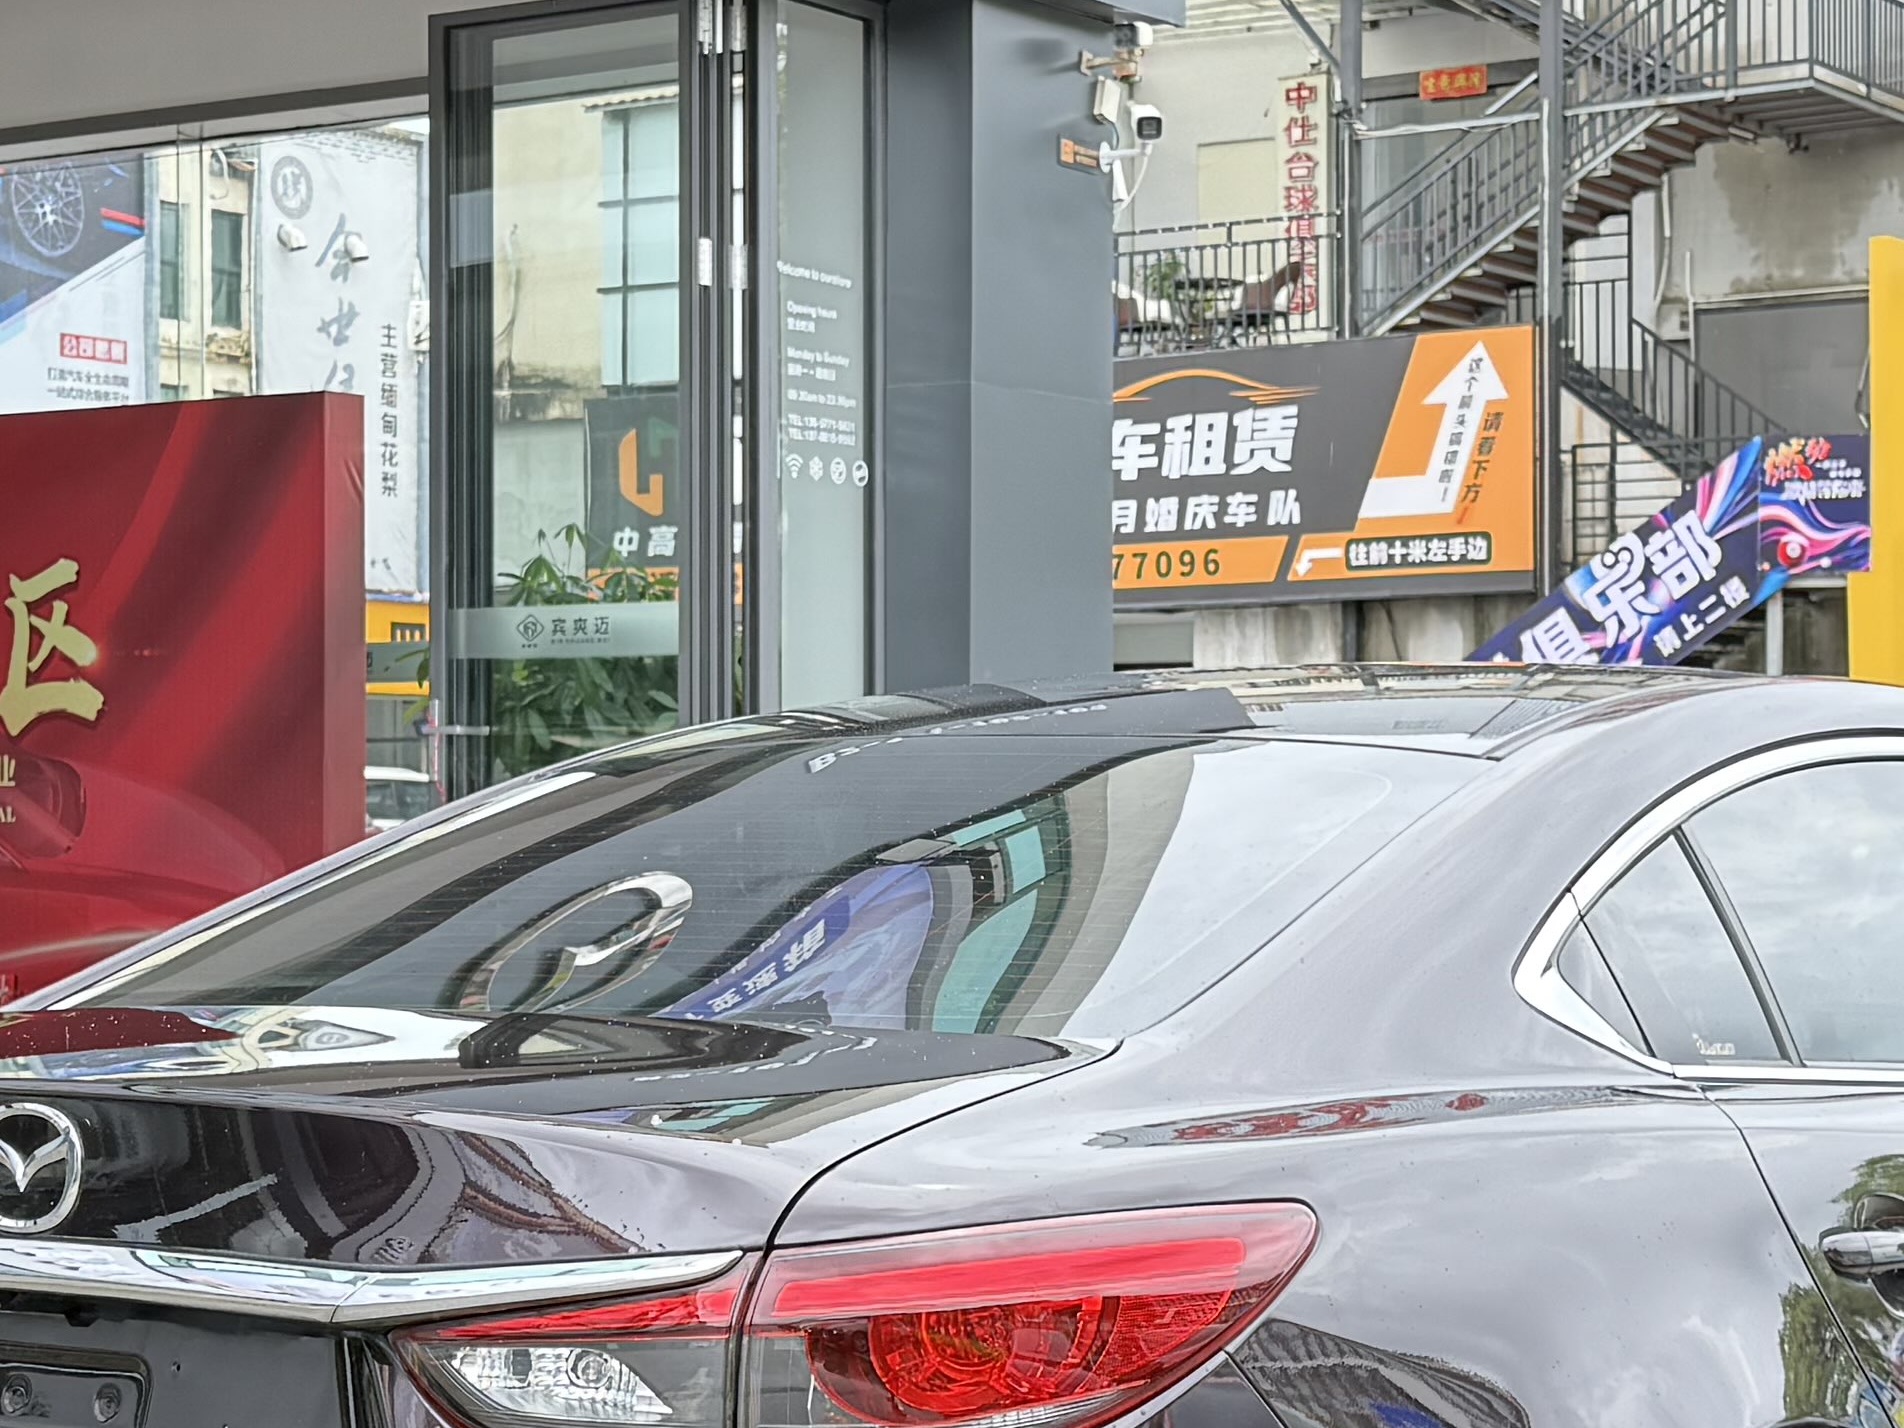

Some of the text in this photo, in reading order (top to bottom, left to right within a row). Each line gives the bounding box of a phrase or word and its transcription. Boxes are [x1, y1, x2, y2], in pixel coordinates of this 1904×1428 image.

[1349, 536, 1488, 567] 往前十米左手边
[551, 616, 610, 637] 宾爽迈
[1653, 575, 1751, 658] 请上二楼
